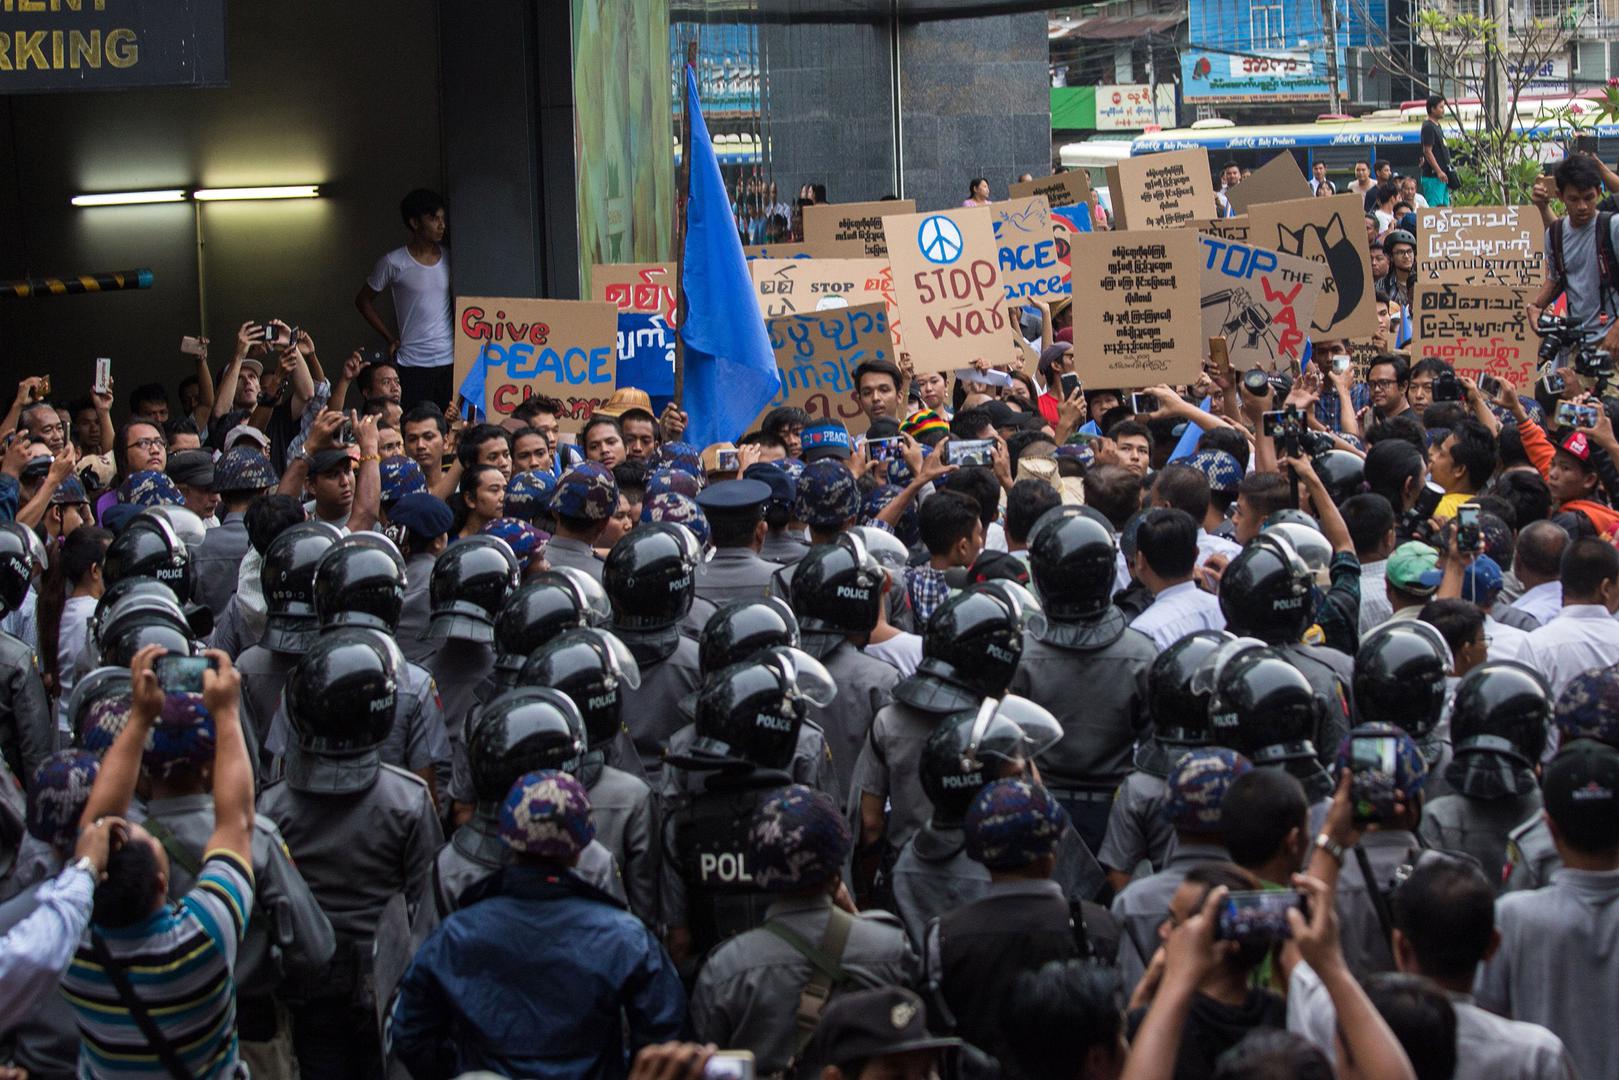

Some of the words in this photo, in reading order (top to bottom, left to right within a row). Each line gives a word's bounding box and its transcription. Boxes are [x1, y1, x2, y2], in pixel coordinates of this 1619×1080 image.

[1259, 137, 1271, 147] Baby
[1273, 136, 1296, 145] Products
[1364, 134, 1377, 144] Baby
[1379, 133, 1403, 142] Products
[998, 240, 1057, 272] ACE
[1203, 239, 1278, 279] TOP
[1281, 268, 1313, 284] THE
[811, 282, 854, 293] STOP
[914, 260, 997, 304] STOP
[462, 306, 550, 345] Give
[1261, 275, 1303, 358] WAR
[483, 343, 613, 385] PEACE
[10, 557, 30, 580] POLICE
[156, 568, 183, 580] POLICE
[837, 585, 869, 600] POLICE
[1273, 597, 1303, 610] POLICE
[986, 643, 1014, 663] POLICE
[756, 713, 791, 732] POLICE
[942, 772, 983, 789] POLICE
[700, 852, 753, 881] POL
